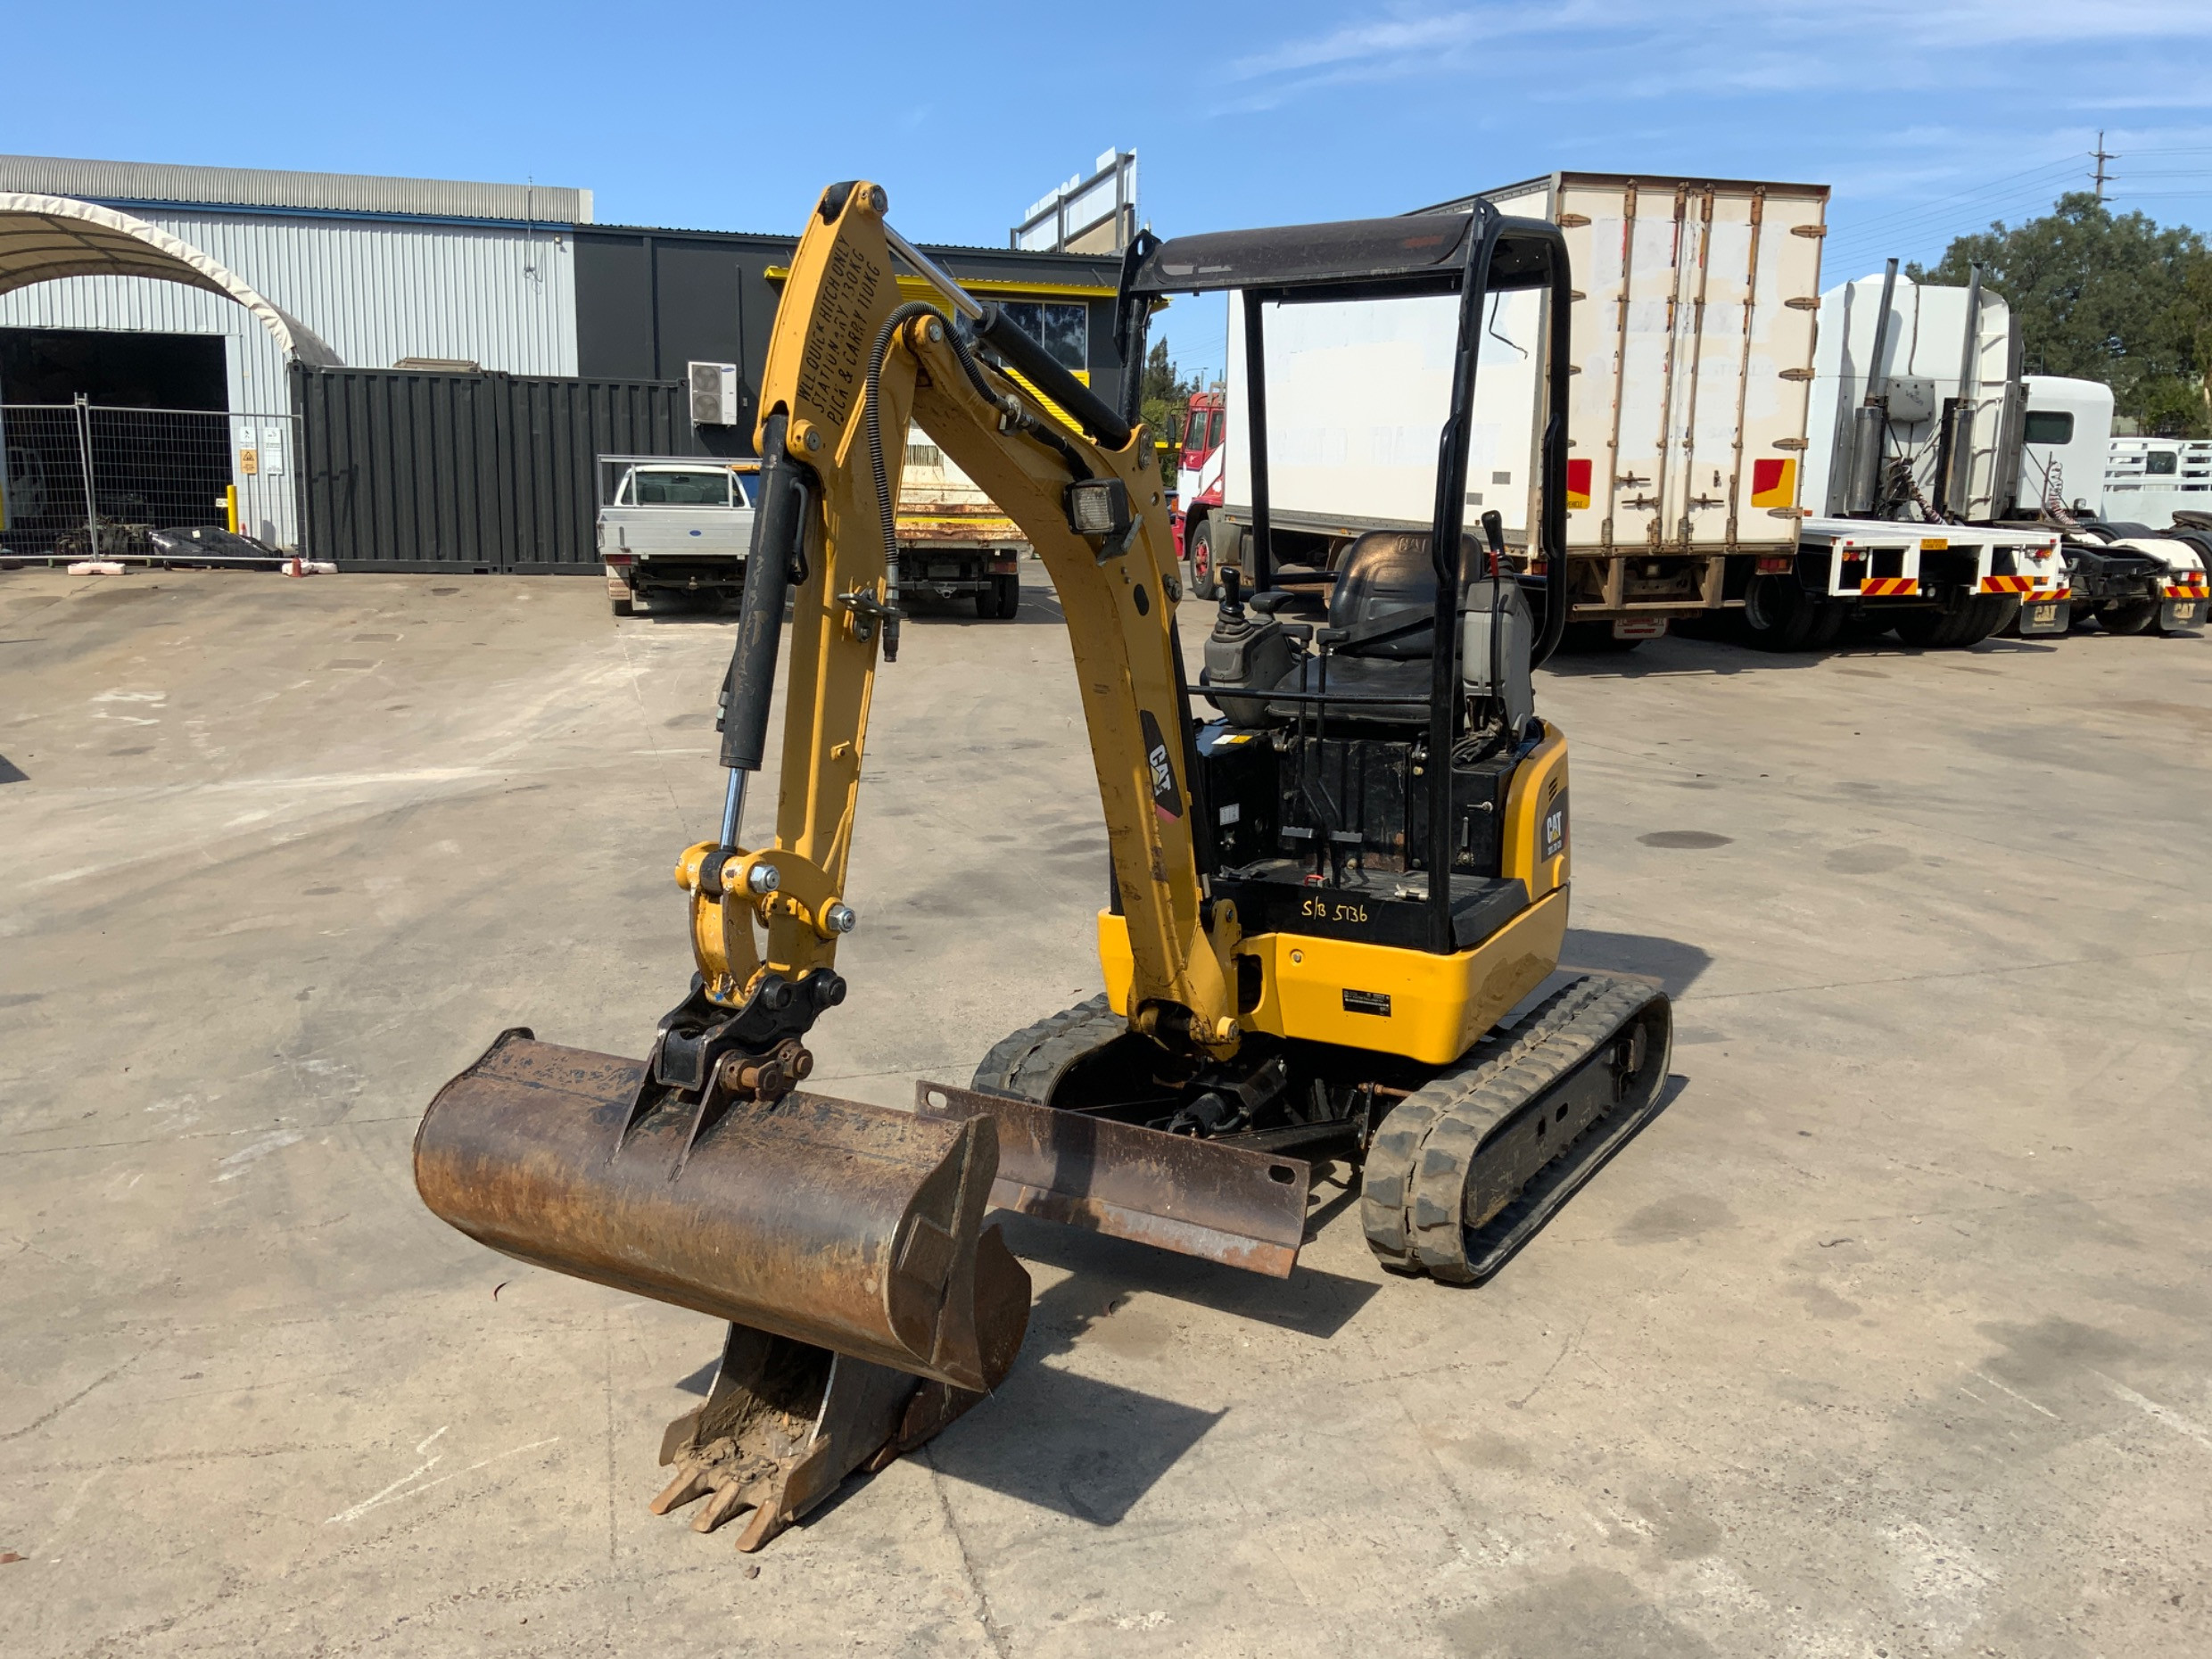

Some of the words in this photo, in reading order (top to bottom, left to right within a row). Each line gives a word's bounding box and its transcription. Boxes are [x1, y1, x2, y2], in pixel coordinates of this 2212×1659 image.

[831, 235, 850, 277] ONLY
[841, 249, 864, 303] 130KG
[819, 276, 840, 323] HITCH
[806, 321, 825, 370] QUICK
[842, 309, 867, 366] CARRY
[797, 373, 816, 401] WLL
[838, 368, 854, 384] &
[1149, 744, 1171, 796] CAT
[1547, 810, 1563, 844] CAT
[1301, 896, 1326, 920] S/B
[1332, 904, 1368, 922] 5136
